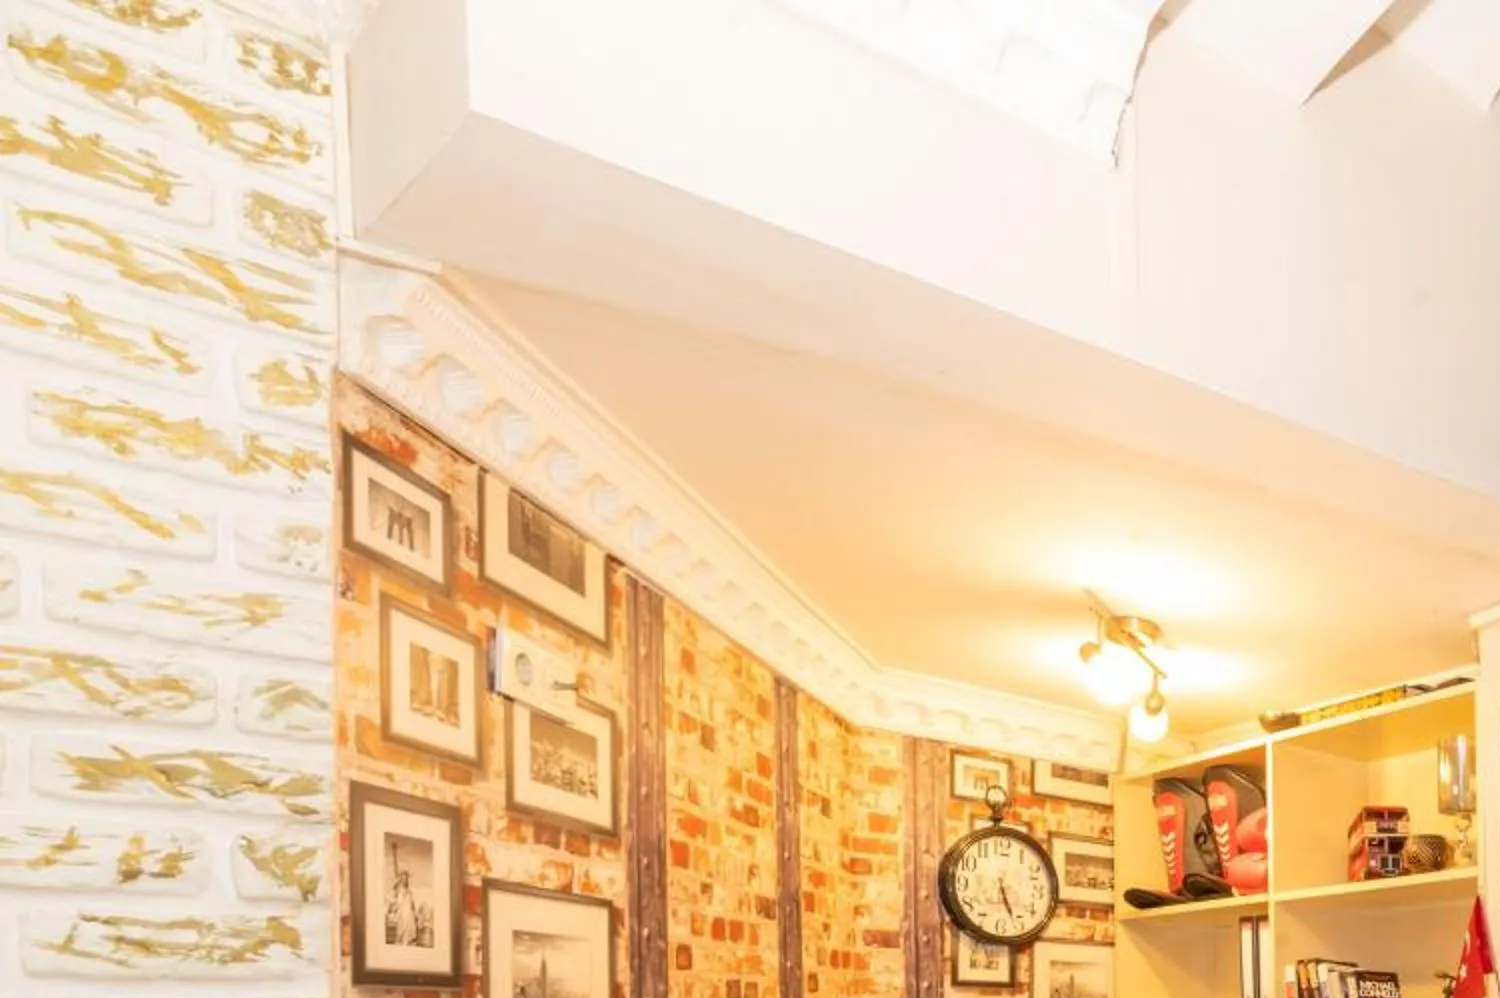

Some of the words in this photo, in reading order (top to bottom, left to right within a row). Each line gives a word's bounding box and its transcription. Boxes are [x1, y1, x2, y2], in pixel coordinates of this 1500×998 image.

[977, 841, 989, 858] 11
[994, 839, 1011, 857] 12
[1019, 848, 1025, 864] 1
[960, 854, 977, 873] 10
[1029, 862, 1041, 880] 2
[957, 875, 969, 892] 9
[995, 918, 1007, 935] 6
